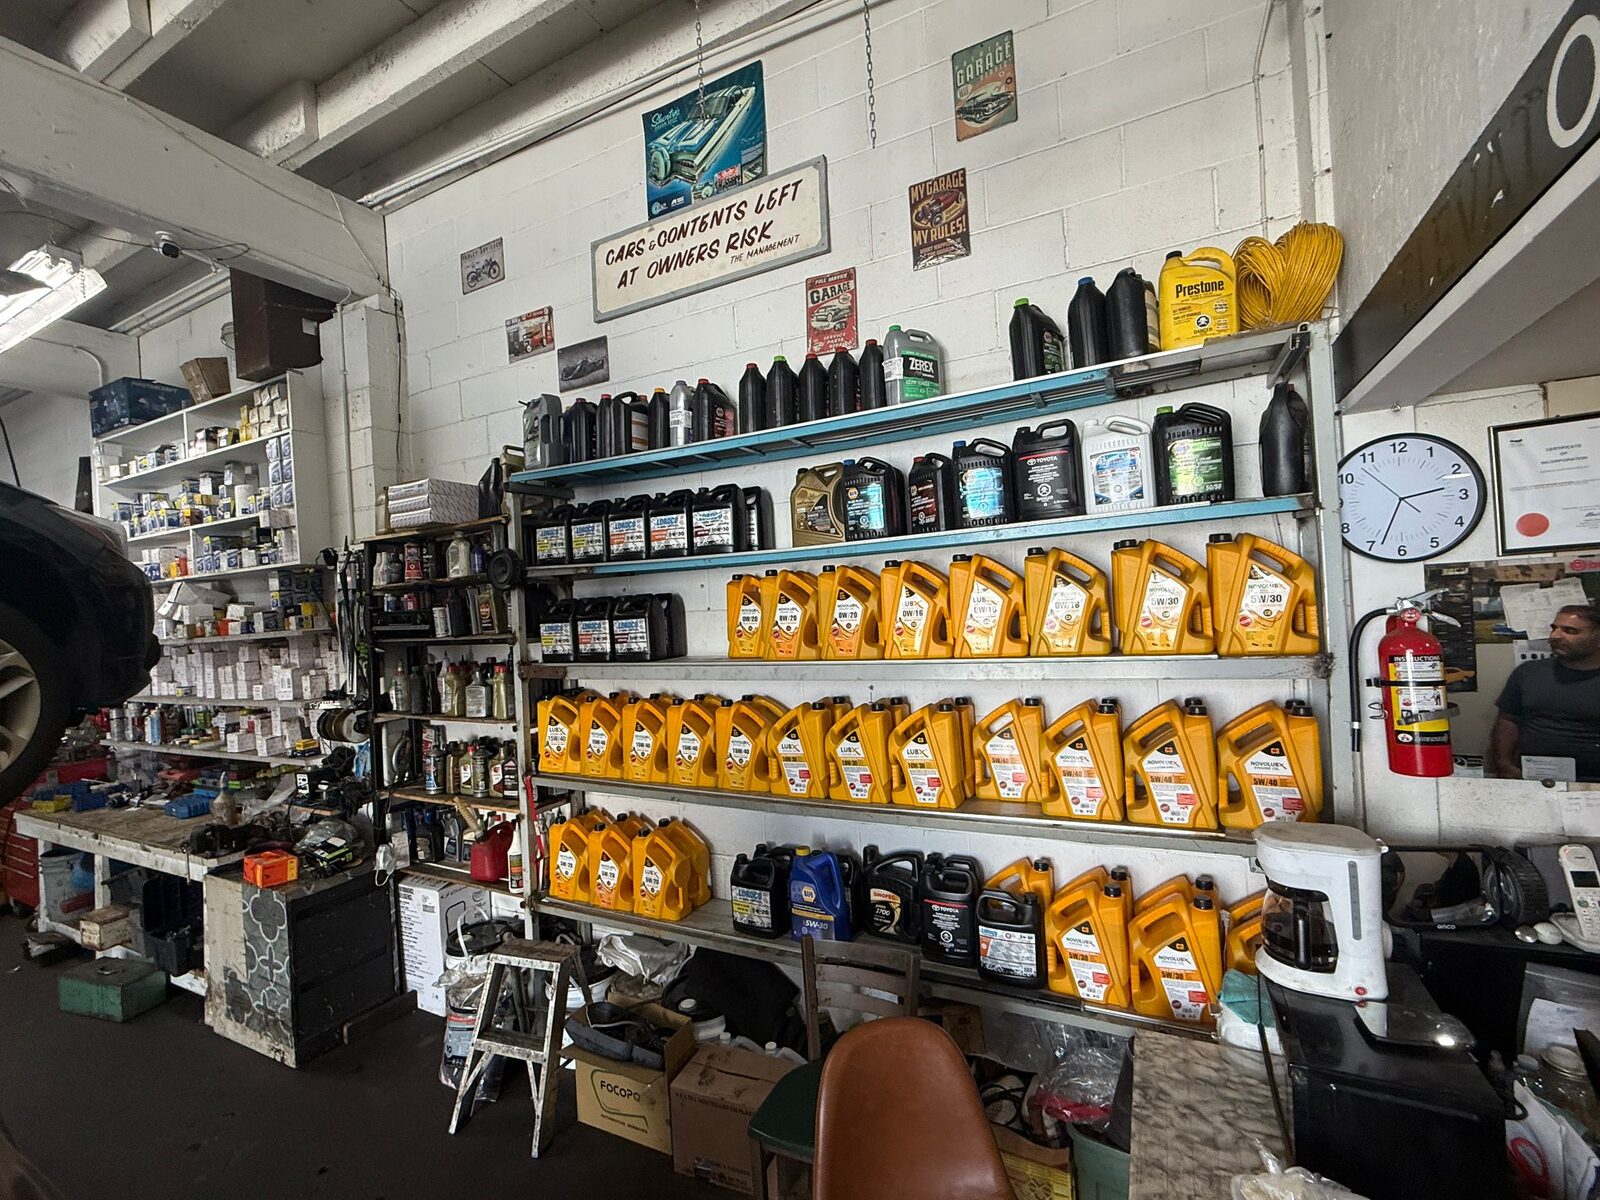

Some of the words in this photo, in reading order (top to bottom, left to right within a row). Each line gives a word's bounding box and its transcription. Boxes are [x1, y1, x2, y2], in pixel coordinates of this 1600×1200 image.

[956, 40, 1011, 87] GARAGE
[911, 183, 926, 203] MY
[926, 171, 964, 194] GARAGE
[605, 238, 645, 265] CARS
[648, 239, 656, 250] &
[656, 200, 748, 248] CONTENTS
[754, 178, 804, 214] LEFT
[913, 229, 929, 247] MY
[930, 214, 967, 242] RULES!
[730, 252, 744, 265] THE
[746, 233, 800, 260] MANAGEMENT
[617, 266, 640, 290] AT
[646, 237, 721, 279] OWNERS
[725, 220, 774, 254] RISK
[810, 281, 851, 305] GARAGE
[1175, 280, 1225, 299] Prestone
[909, 357, 934, 374] ZEREX
[1389, 441, 1408, 454] 12
[1426, 447, 1434, 457] 1
[1036, 455, 1058, 463] TOYOTA
[1361, 452, 1375, 463] 11
[1451, 463, 1462, 475] 2
[1338, 473, 1355, 484] 10
[1459, 488, 1469, 500] 3
[1454, 515, 1465, 527] 4
[1341, 522, 1350, 534] 8
[1366, 540, 1376, 552] 7
[1429, 537, 1440, 549] 5
[1397, 545, 1407, 557] 6
[1151, 597, 1179, 606] 5W/30
[1250, 594, 1282, 603] 5W/30
[742, 615, 758, 623] 0W/20
[779, 614, 797, 622] 0W/20
[838, 611, 858, 619] 0W/20
[902, 609, 924, 618] 0W/16
[781, 743, 800, 752] LUBX
[840, 746, 860, 756] LUBX
[906, 748, 928, 758] LUBX
[1062, 769, 1083, 778] 5W/40
[1253, 777, 1278, 786] 5W/40
[940, 906, 960, 914] TOYOTA
[805, 920, 829, 930] 5W-30
[1068, 952, 1089, 961] 5W/30
[1161, 970, 1184, 980] 5W/30
